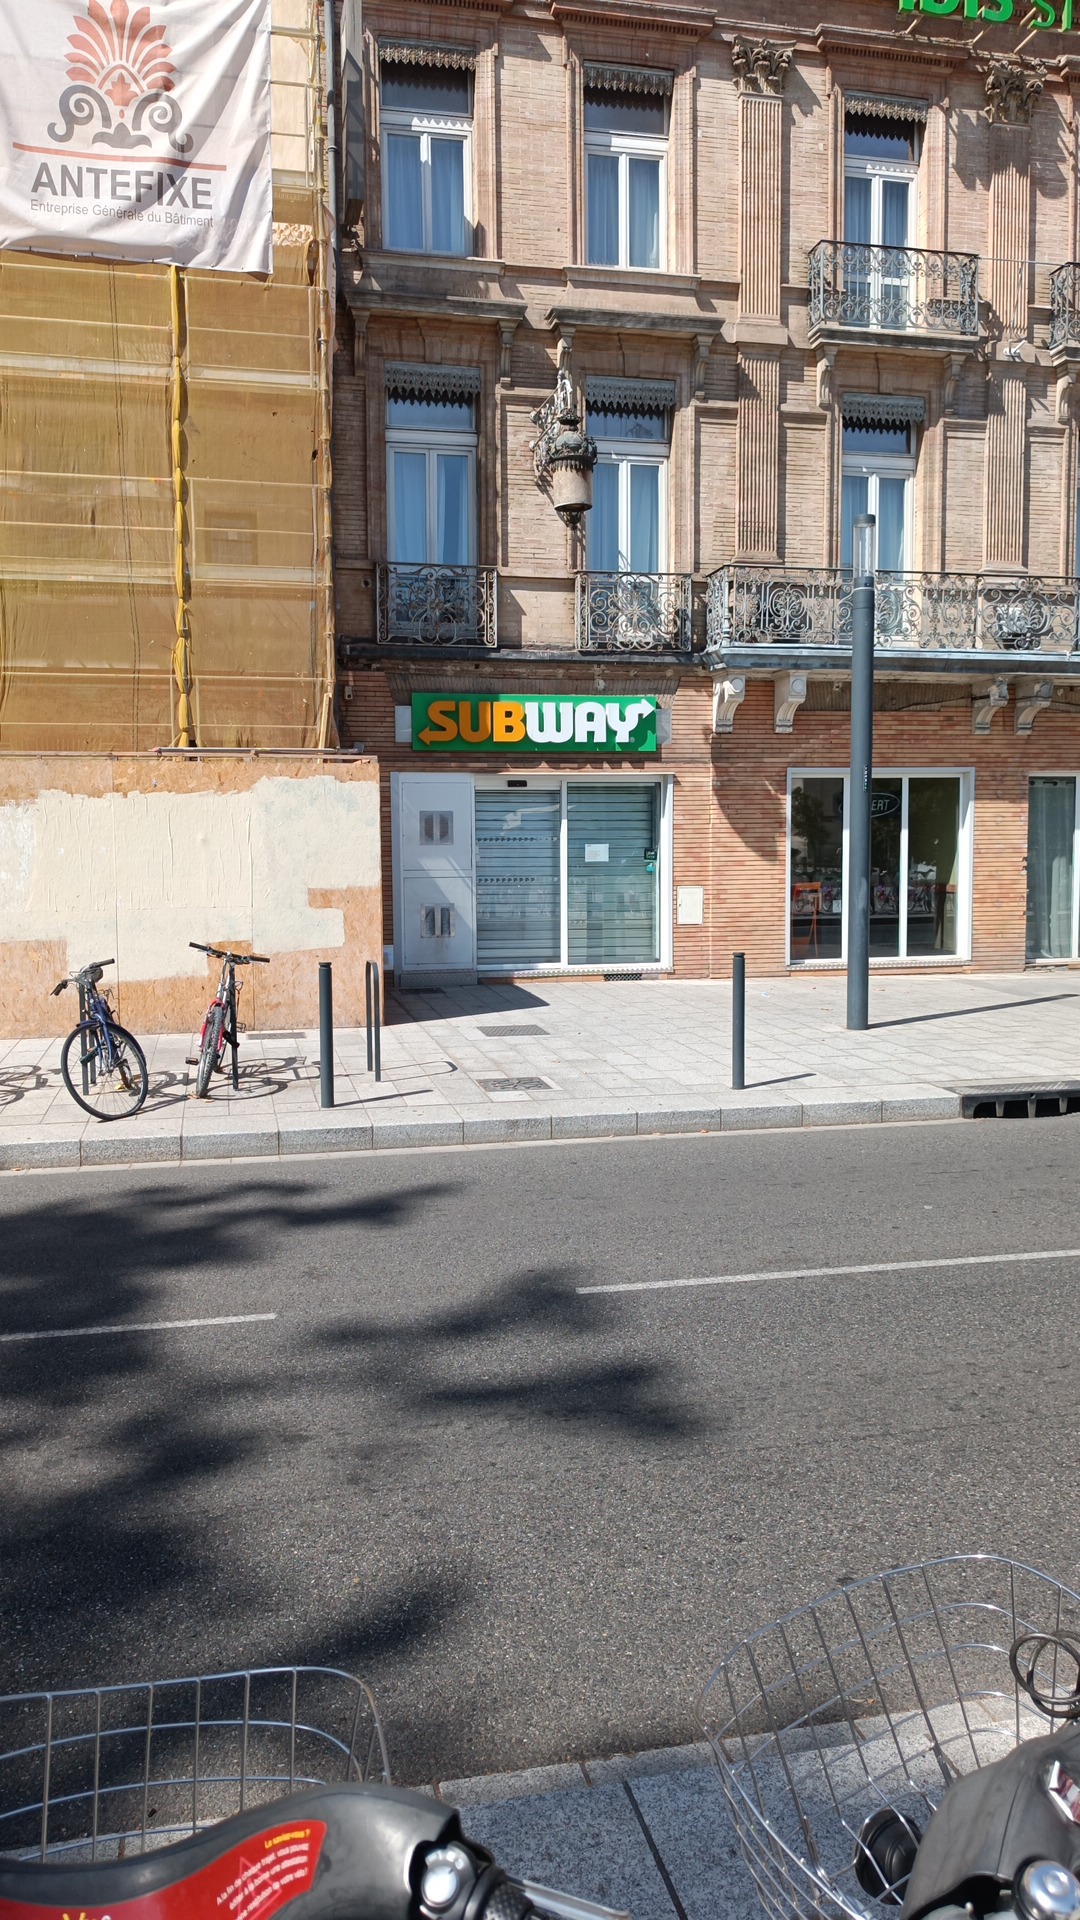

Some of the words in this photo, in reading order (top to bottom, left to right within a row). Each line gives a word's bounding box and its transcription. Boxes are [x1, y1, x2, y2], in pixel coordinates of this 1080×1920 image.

[31, 162, 213, 210] ANTEFIXE
[30, 199, 88, 217] Entreprise
[92, 204, 144, 223] Générale
[147, 211, 162, 224] du
[165, 211, 214, 229] Bâtiment
[418, 697, 656, 746] SUBWAY
